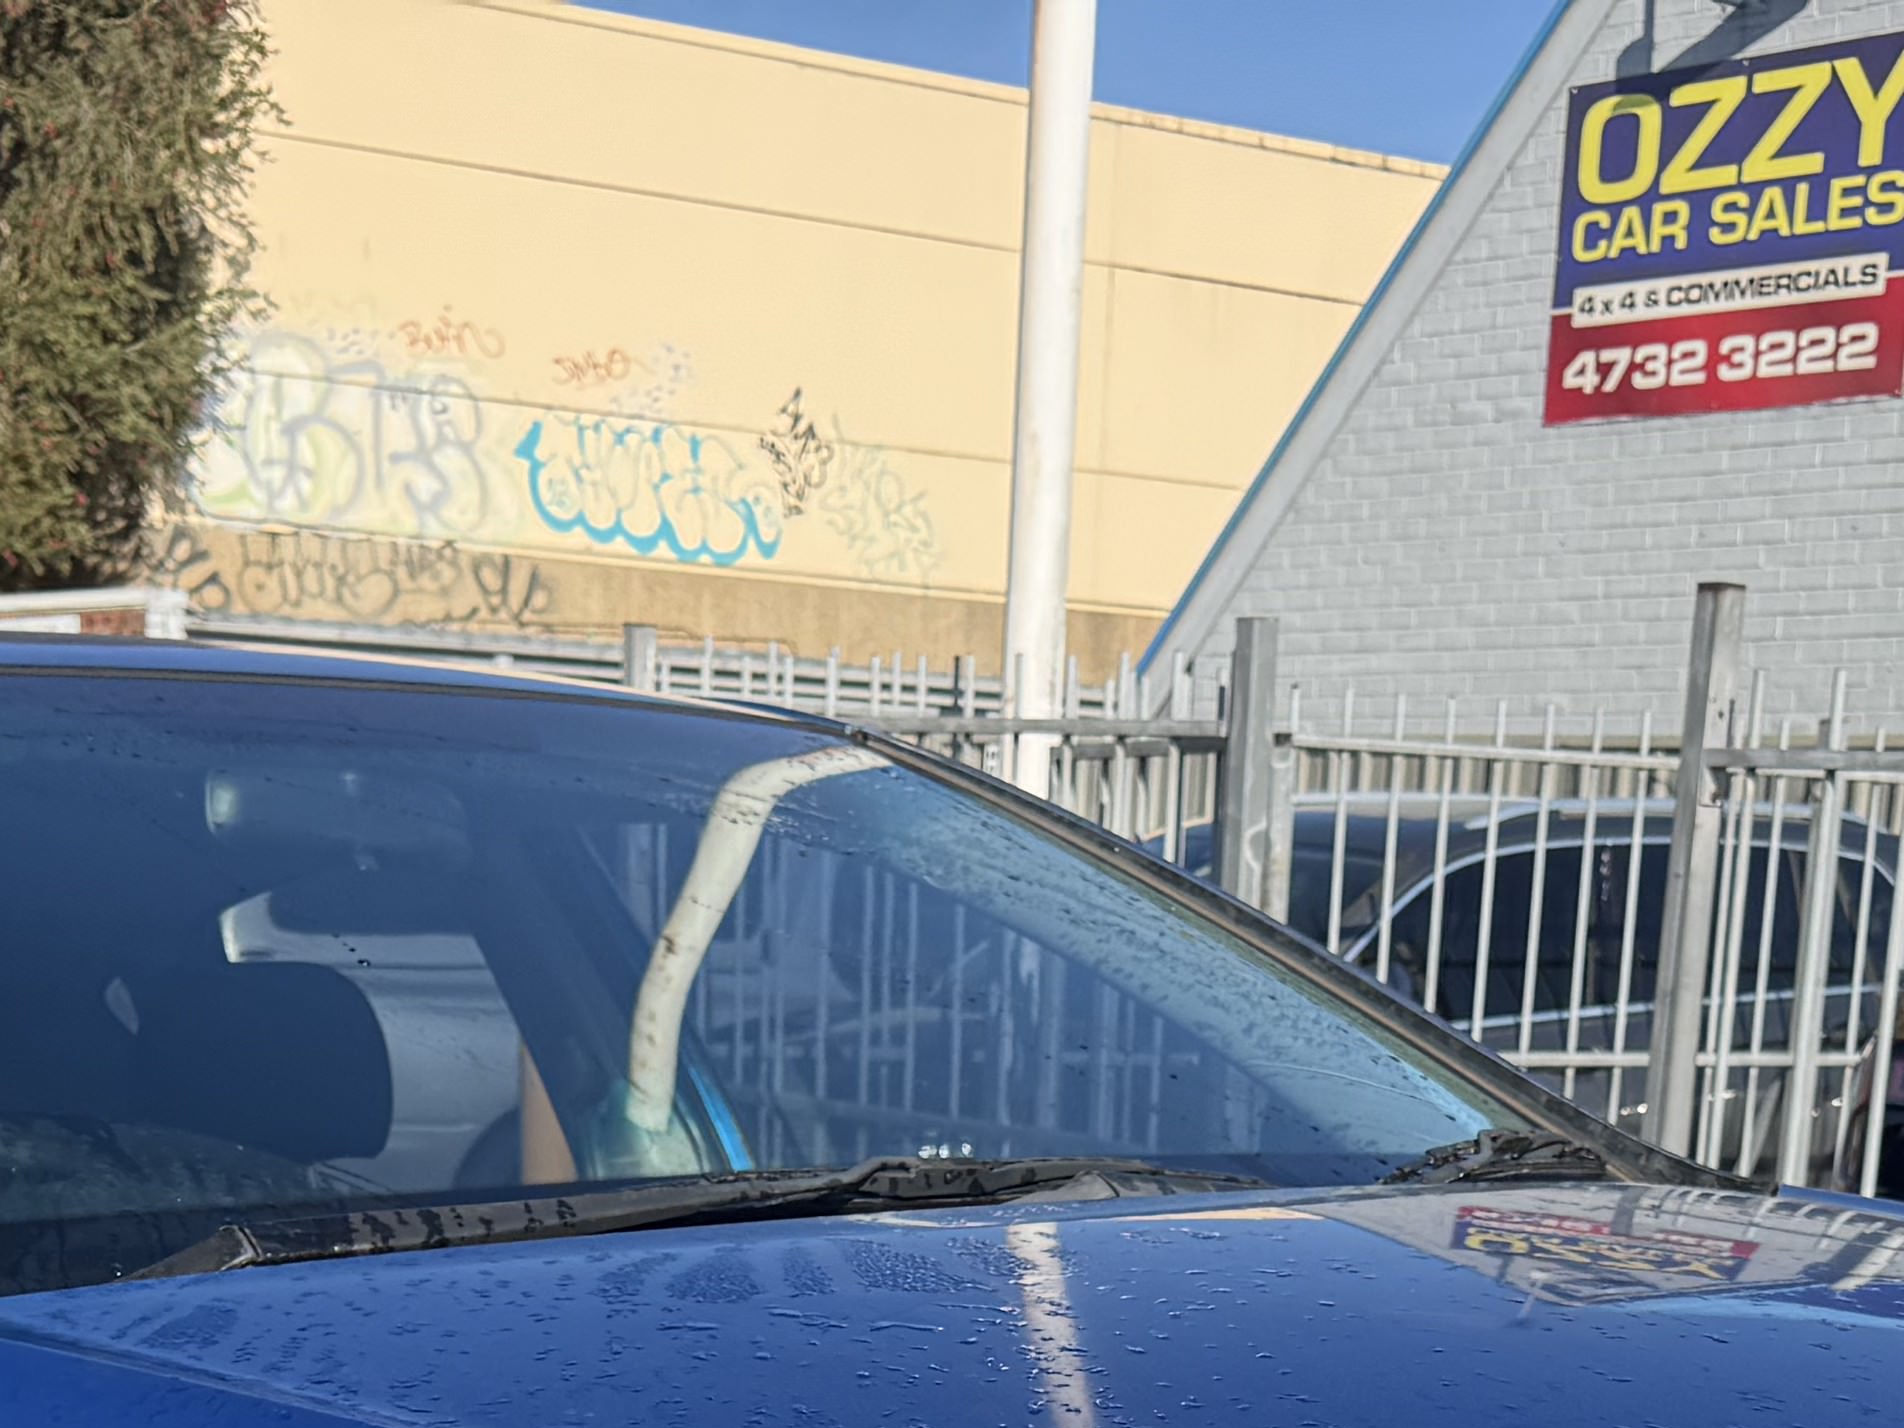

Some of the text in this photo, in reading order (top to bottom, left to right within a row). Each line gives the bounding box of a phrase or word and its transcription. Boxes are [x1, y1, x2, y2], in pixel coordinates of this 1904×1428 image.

[1572, 200, 1691, 263] CAR
[1666, 263, 1879, 307] COMMERCIALS
[1561, 321, 1880, 395] 4732 3222
